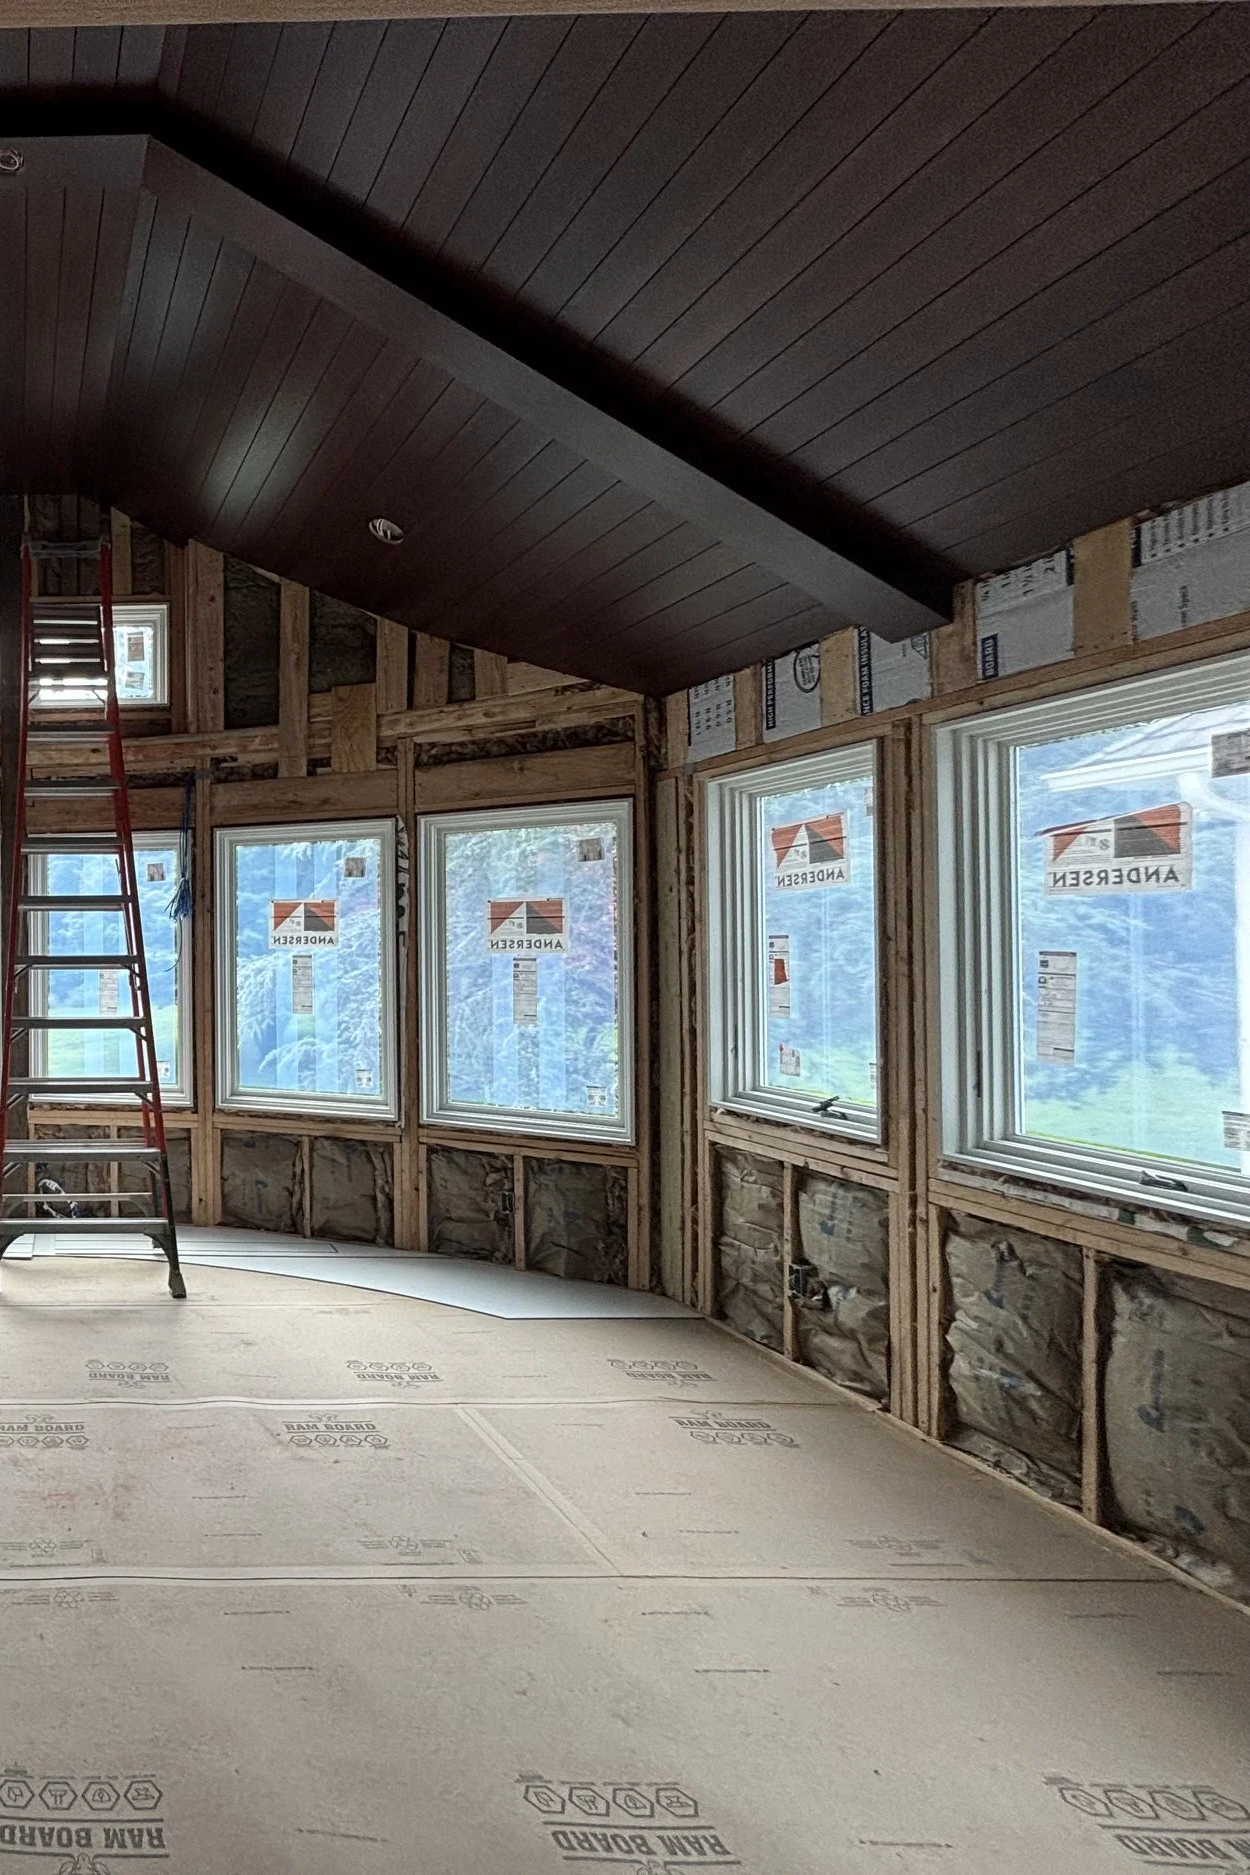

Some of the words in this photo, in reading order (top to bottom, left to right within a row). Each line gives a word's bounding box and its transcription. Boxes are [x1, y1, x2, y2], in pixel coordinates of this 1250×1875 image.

[985, 638, 995, 676] BOARD
[861, 666, 869, 693] FOAM
[767, 706, 775, 727] HIGH
[34, 1424, 85, 1432] BOARD
[283, 1423, 320, 1431] RAM
[323, 1423, 378, 1431] BOARD
[675, 1419, 715, 1427] RAM
[716, 1420, 773, 1429] BOARD
[103, 1827, 166, 1849] RAM
[550, 1829, 658, 1856] BOARD
[655, 1834, 732, 1856] RAM
[1113, 1834, 1237, 1861] BOARD
